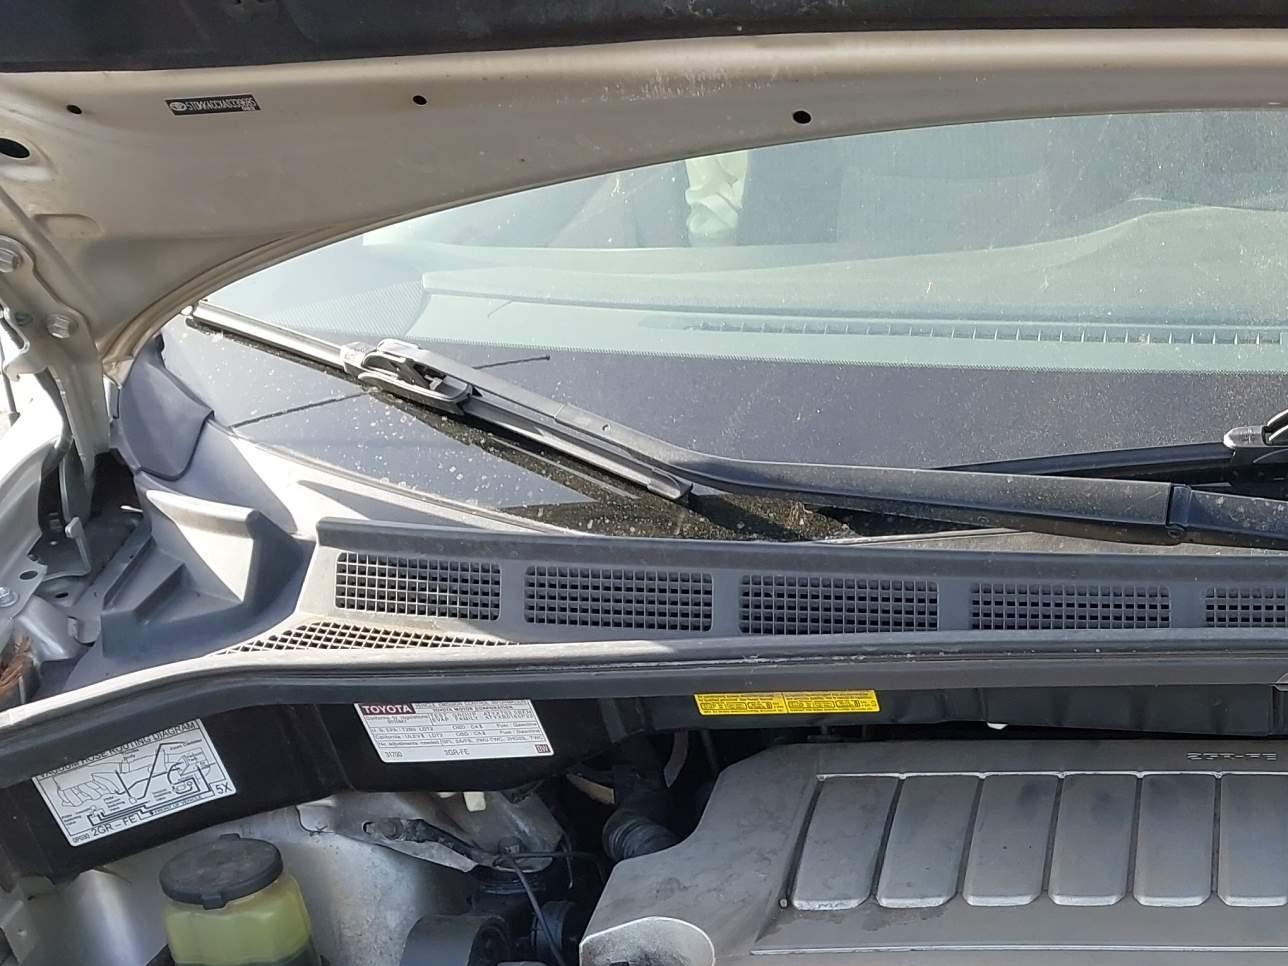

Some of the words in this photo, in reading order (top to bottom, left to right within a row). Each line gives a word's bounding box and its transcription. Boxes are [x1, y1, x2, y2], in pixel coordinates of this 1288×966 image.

[362, 704, 412, 714] TOYOTA
[152, 722, 195, 741] DIAGRAM
[215, 782, 232, 795] 5X
